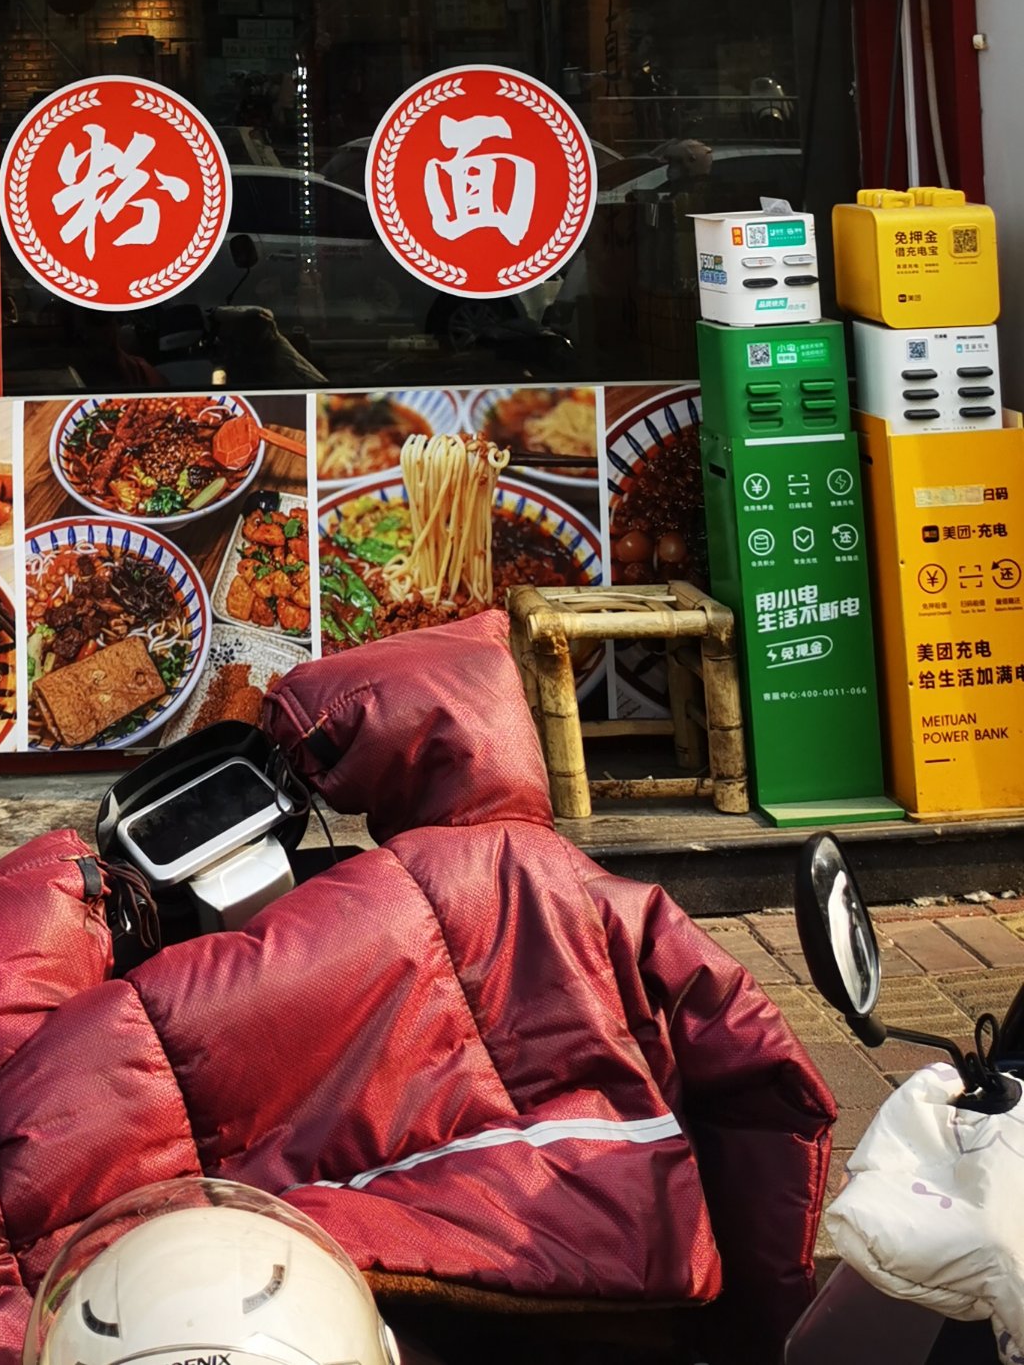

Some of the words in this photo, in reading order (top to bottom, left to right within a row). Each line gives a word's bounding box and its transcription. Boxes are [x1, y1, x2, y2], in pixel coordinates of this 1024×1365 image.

[424, 115, 536, 247] 面
[52, 123, 190, 262] 粉
[895, 230, 937, 245] 免押金
[895, 246, 938, 257] 借充电宝
[1000, 567, 1014, 580] 还
[756, 585, 818, 613] 用小电
[758, 597, 859, 633] 生活不断电
[917, 639, 992, 662] 美团充电
[921, 713, 976, 728] MEITUAN
[923, 730, 968, 744] POWER
[974, 727, 1009, 741] BANK
